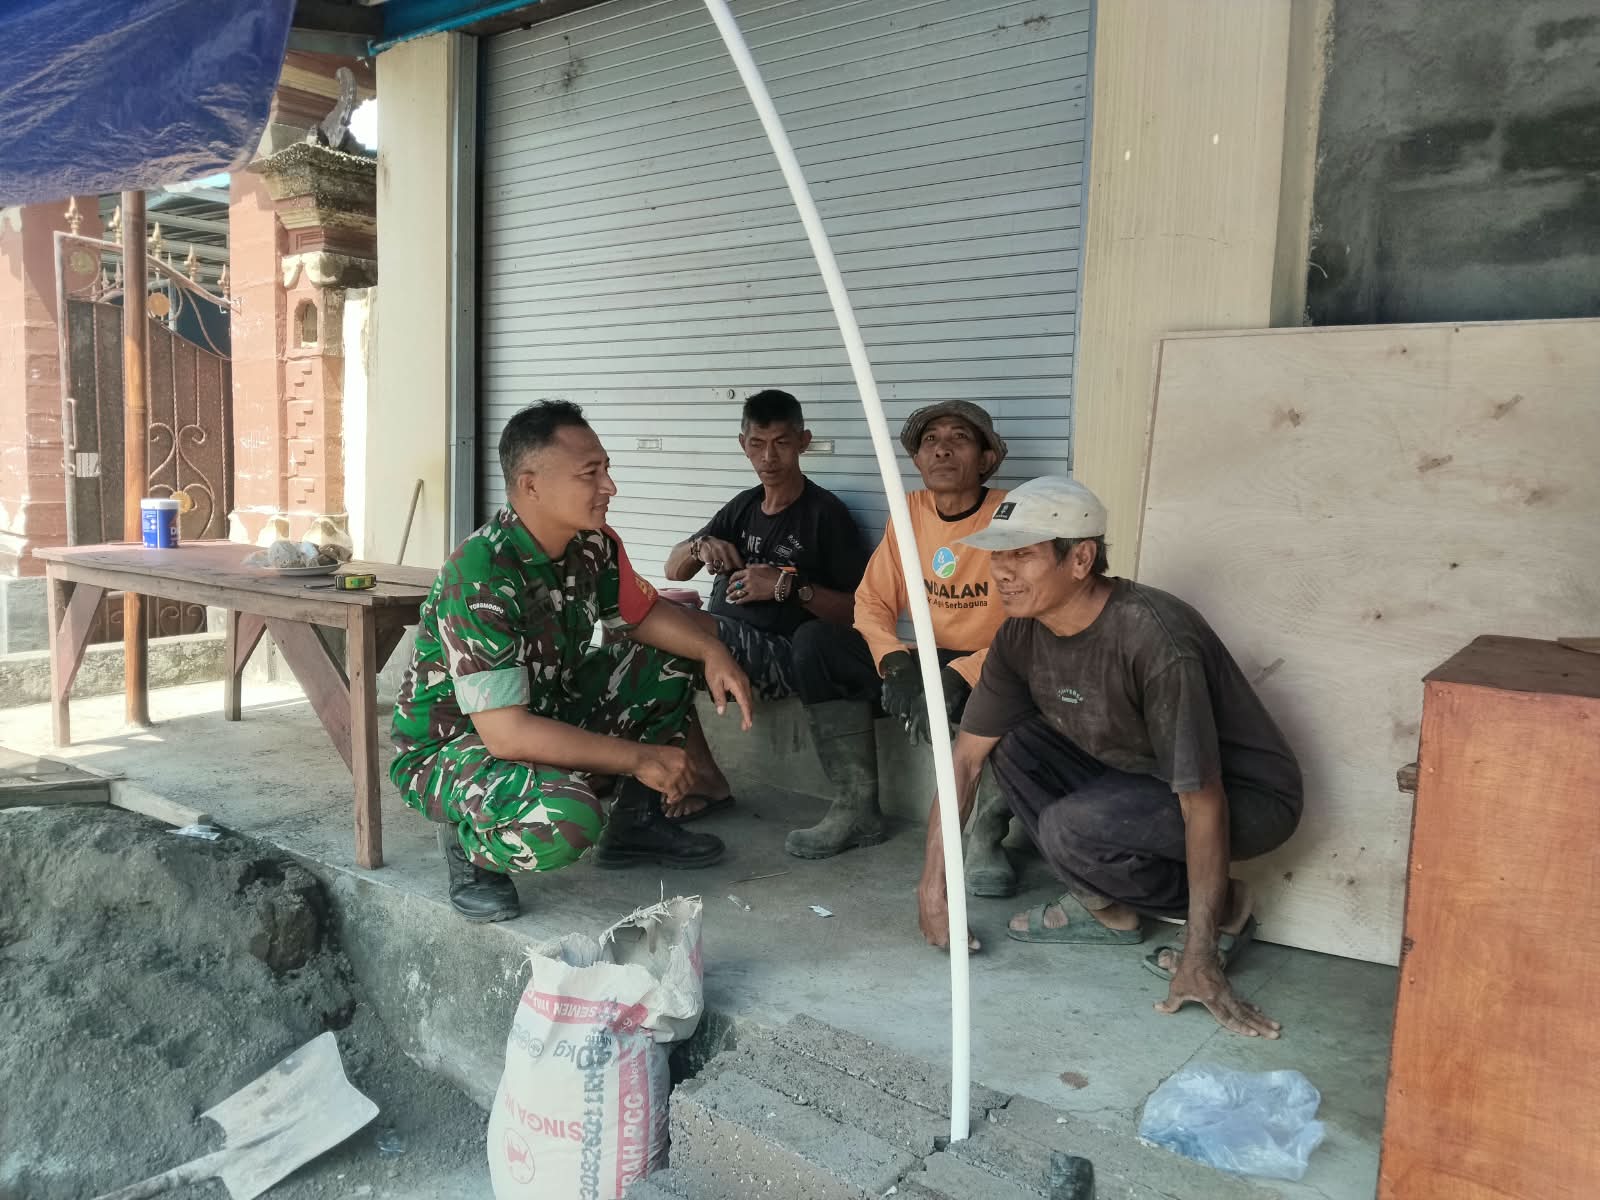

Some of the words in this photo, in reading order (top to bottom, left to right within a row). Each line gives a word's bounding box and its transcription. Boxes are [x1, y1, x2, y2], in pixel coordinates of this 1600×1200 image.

[924, 579, 989, 599] NDALAN
[945, 600, 988, 609] Serbaguna
[552, 1002, 598, 1018] SEMEN
[623, 1093, 645, 1139] PCC
